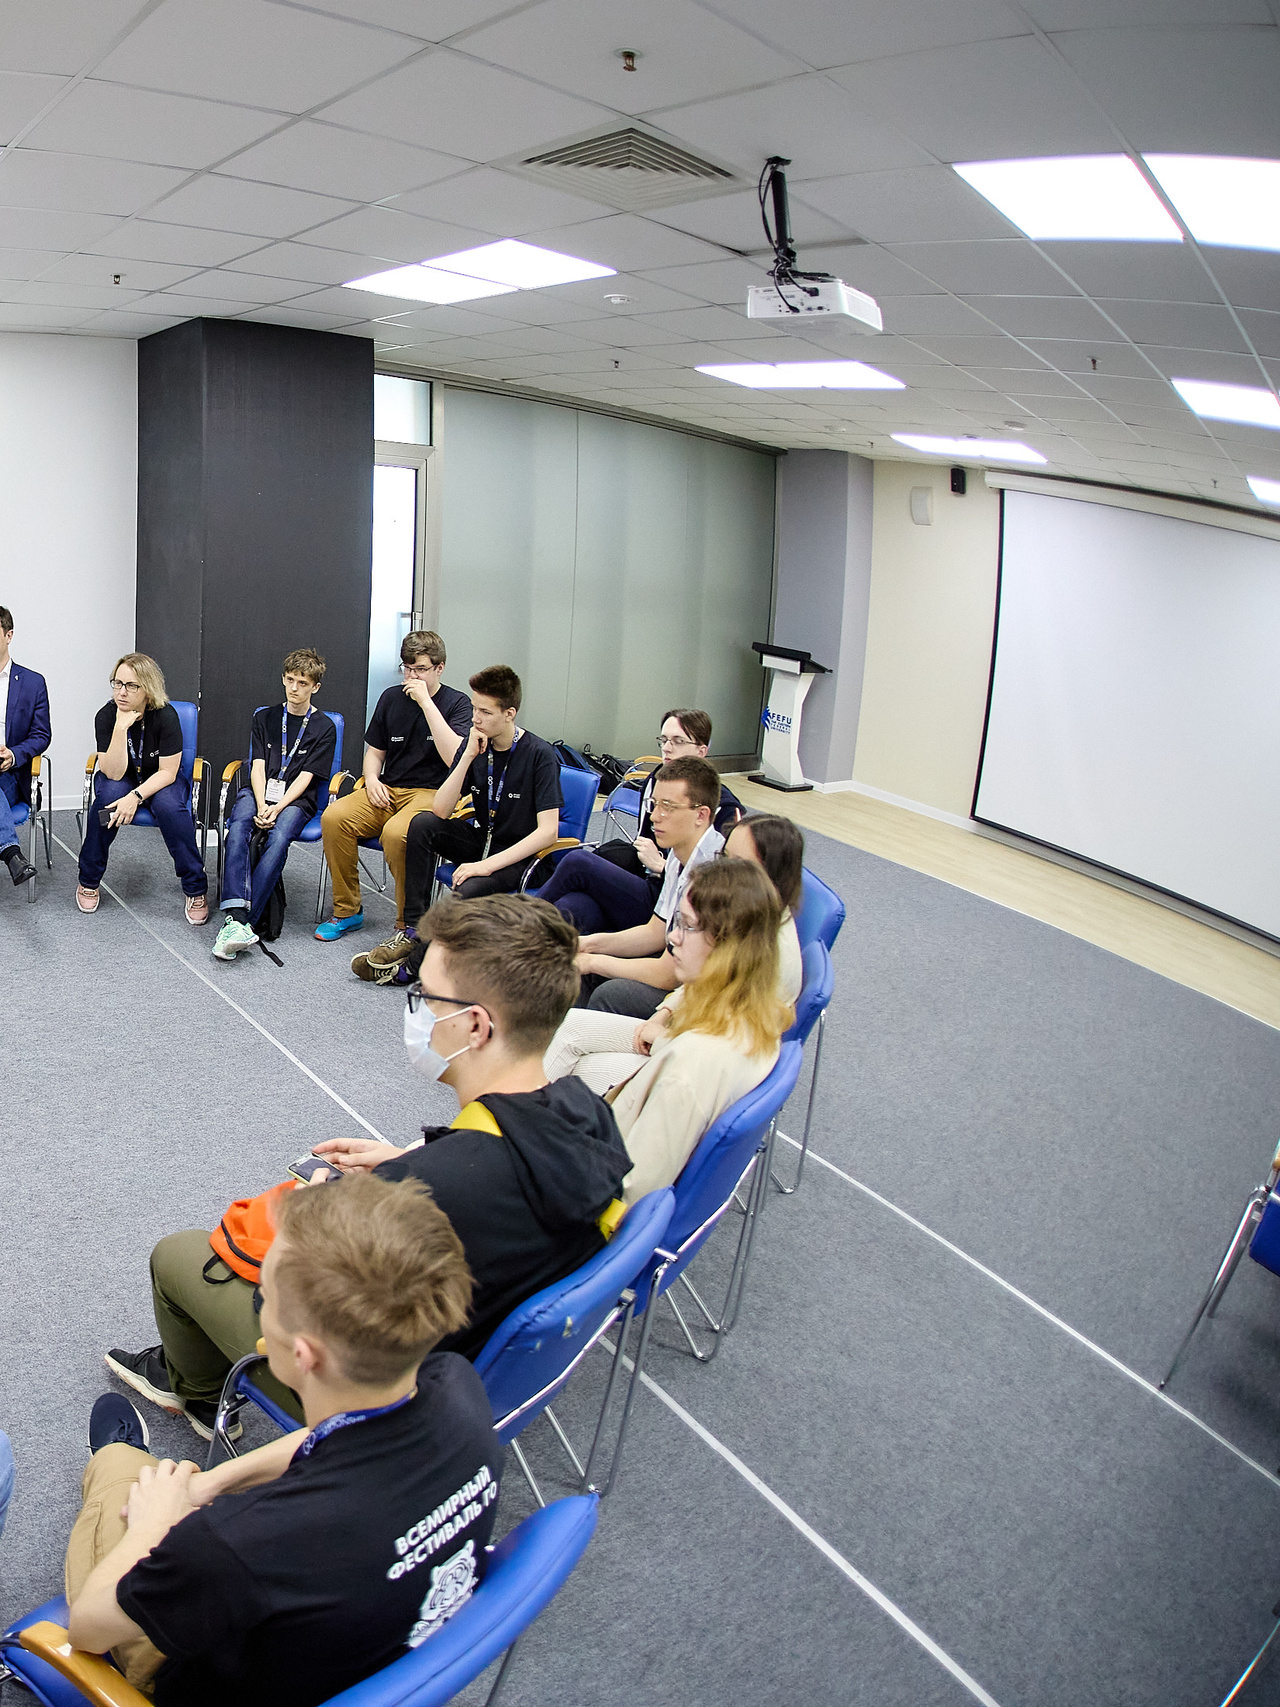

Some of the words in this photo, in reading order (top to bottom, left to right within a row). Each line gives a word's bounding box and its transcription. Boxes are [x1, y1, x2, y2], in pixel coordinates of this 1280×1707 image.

[771, 713, 792, 724] FEFU
[386, 1500, 482, 1580] ФЕСТИВАЛЬ
[482, 1480, 497, 1507] ГО
[394, 1464, 491, 1556] ВСЕМИРНЫЙ
